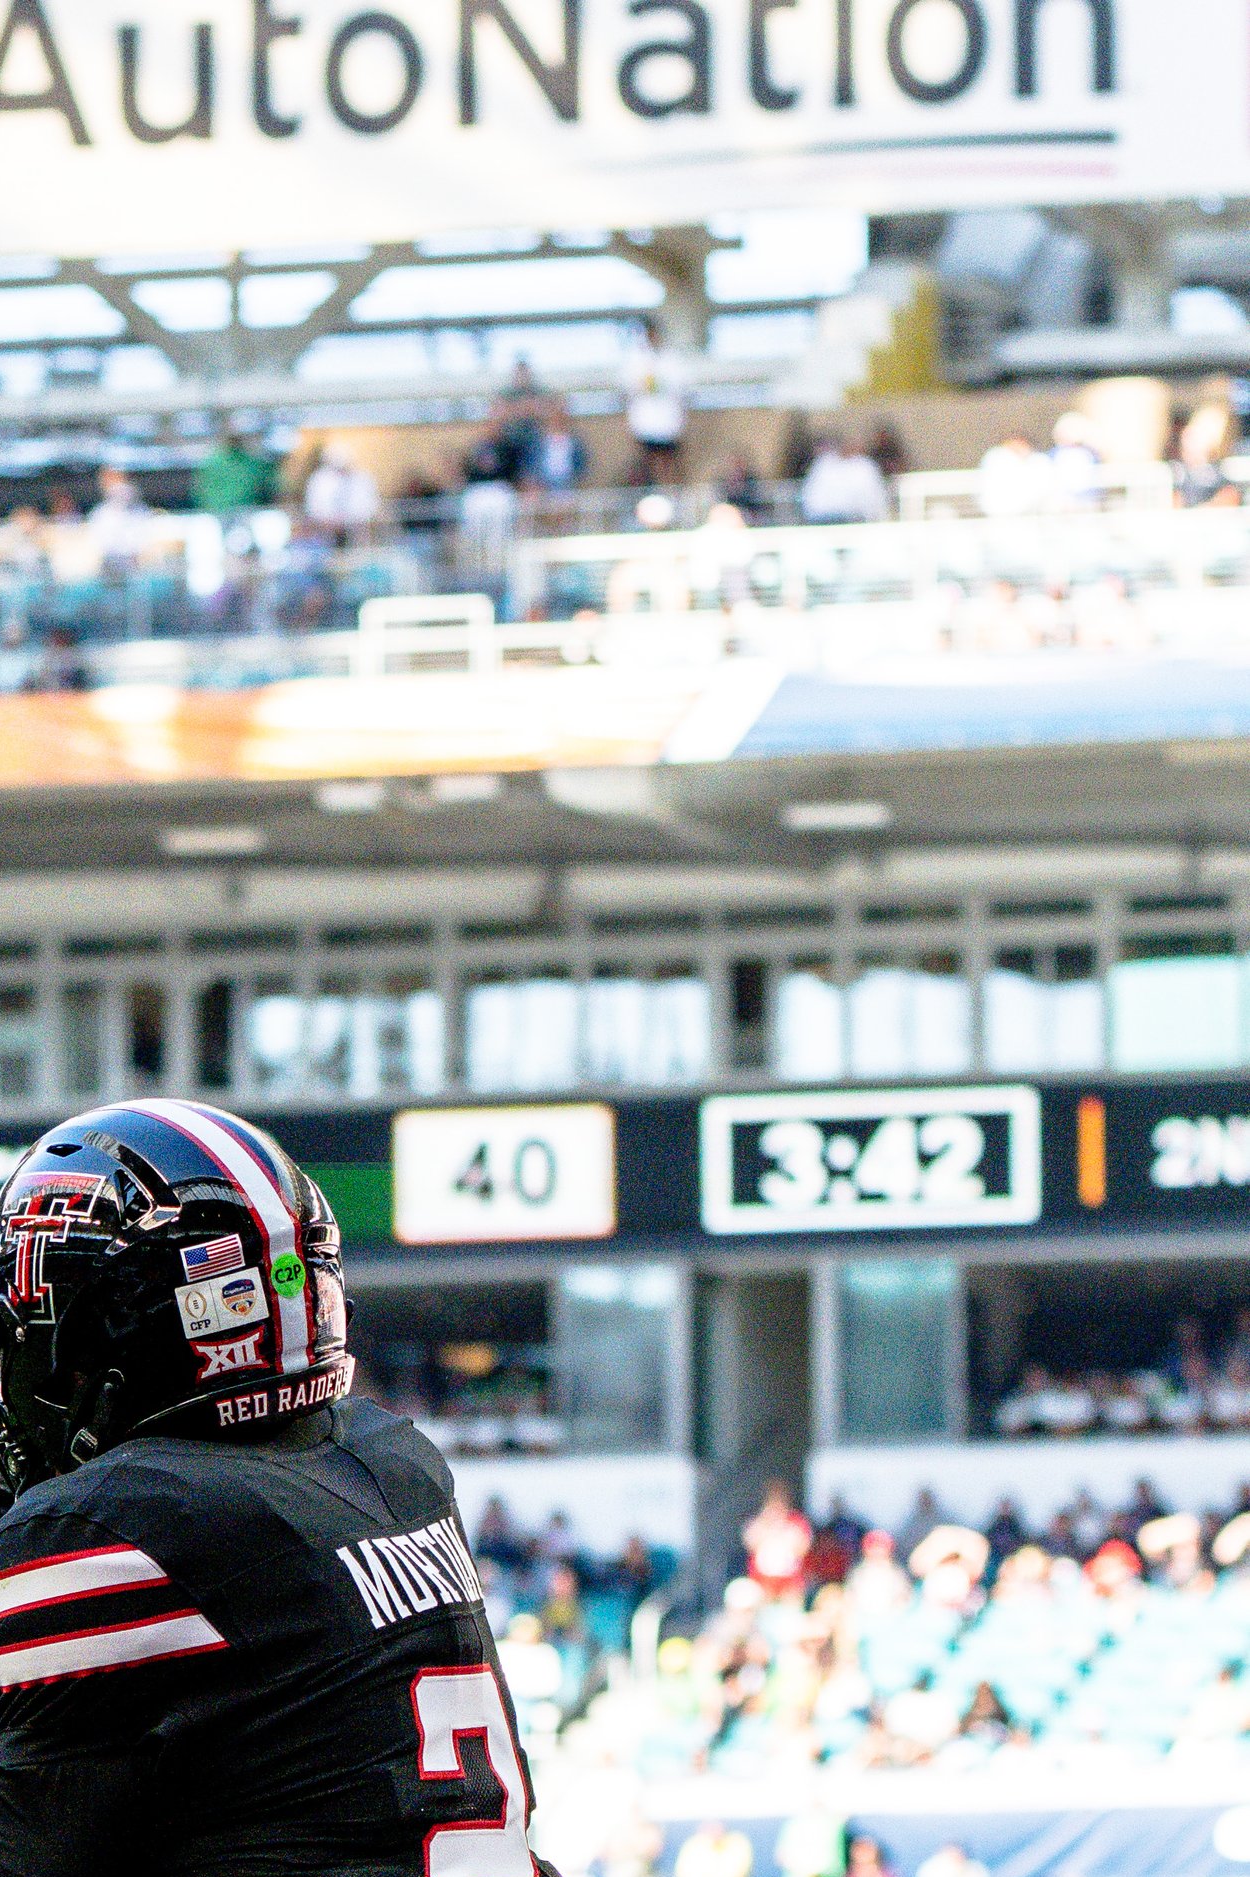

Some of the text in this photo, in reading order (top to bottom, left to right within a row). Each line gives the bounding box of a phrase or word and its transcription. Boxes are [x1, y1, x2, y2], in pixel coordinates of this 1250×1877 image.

[453, 1136, 557, 1207] 40
[757, 1112, 988, 1207] 3:42
[274, 1264, 302, 1284] C2P
[190, 1318, 211, 1332] CFP
[195, 1331, 265, 1380] XII
[217, 1366, 351, 1427] RED RAIDERS
